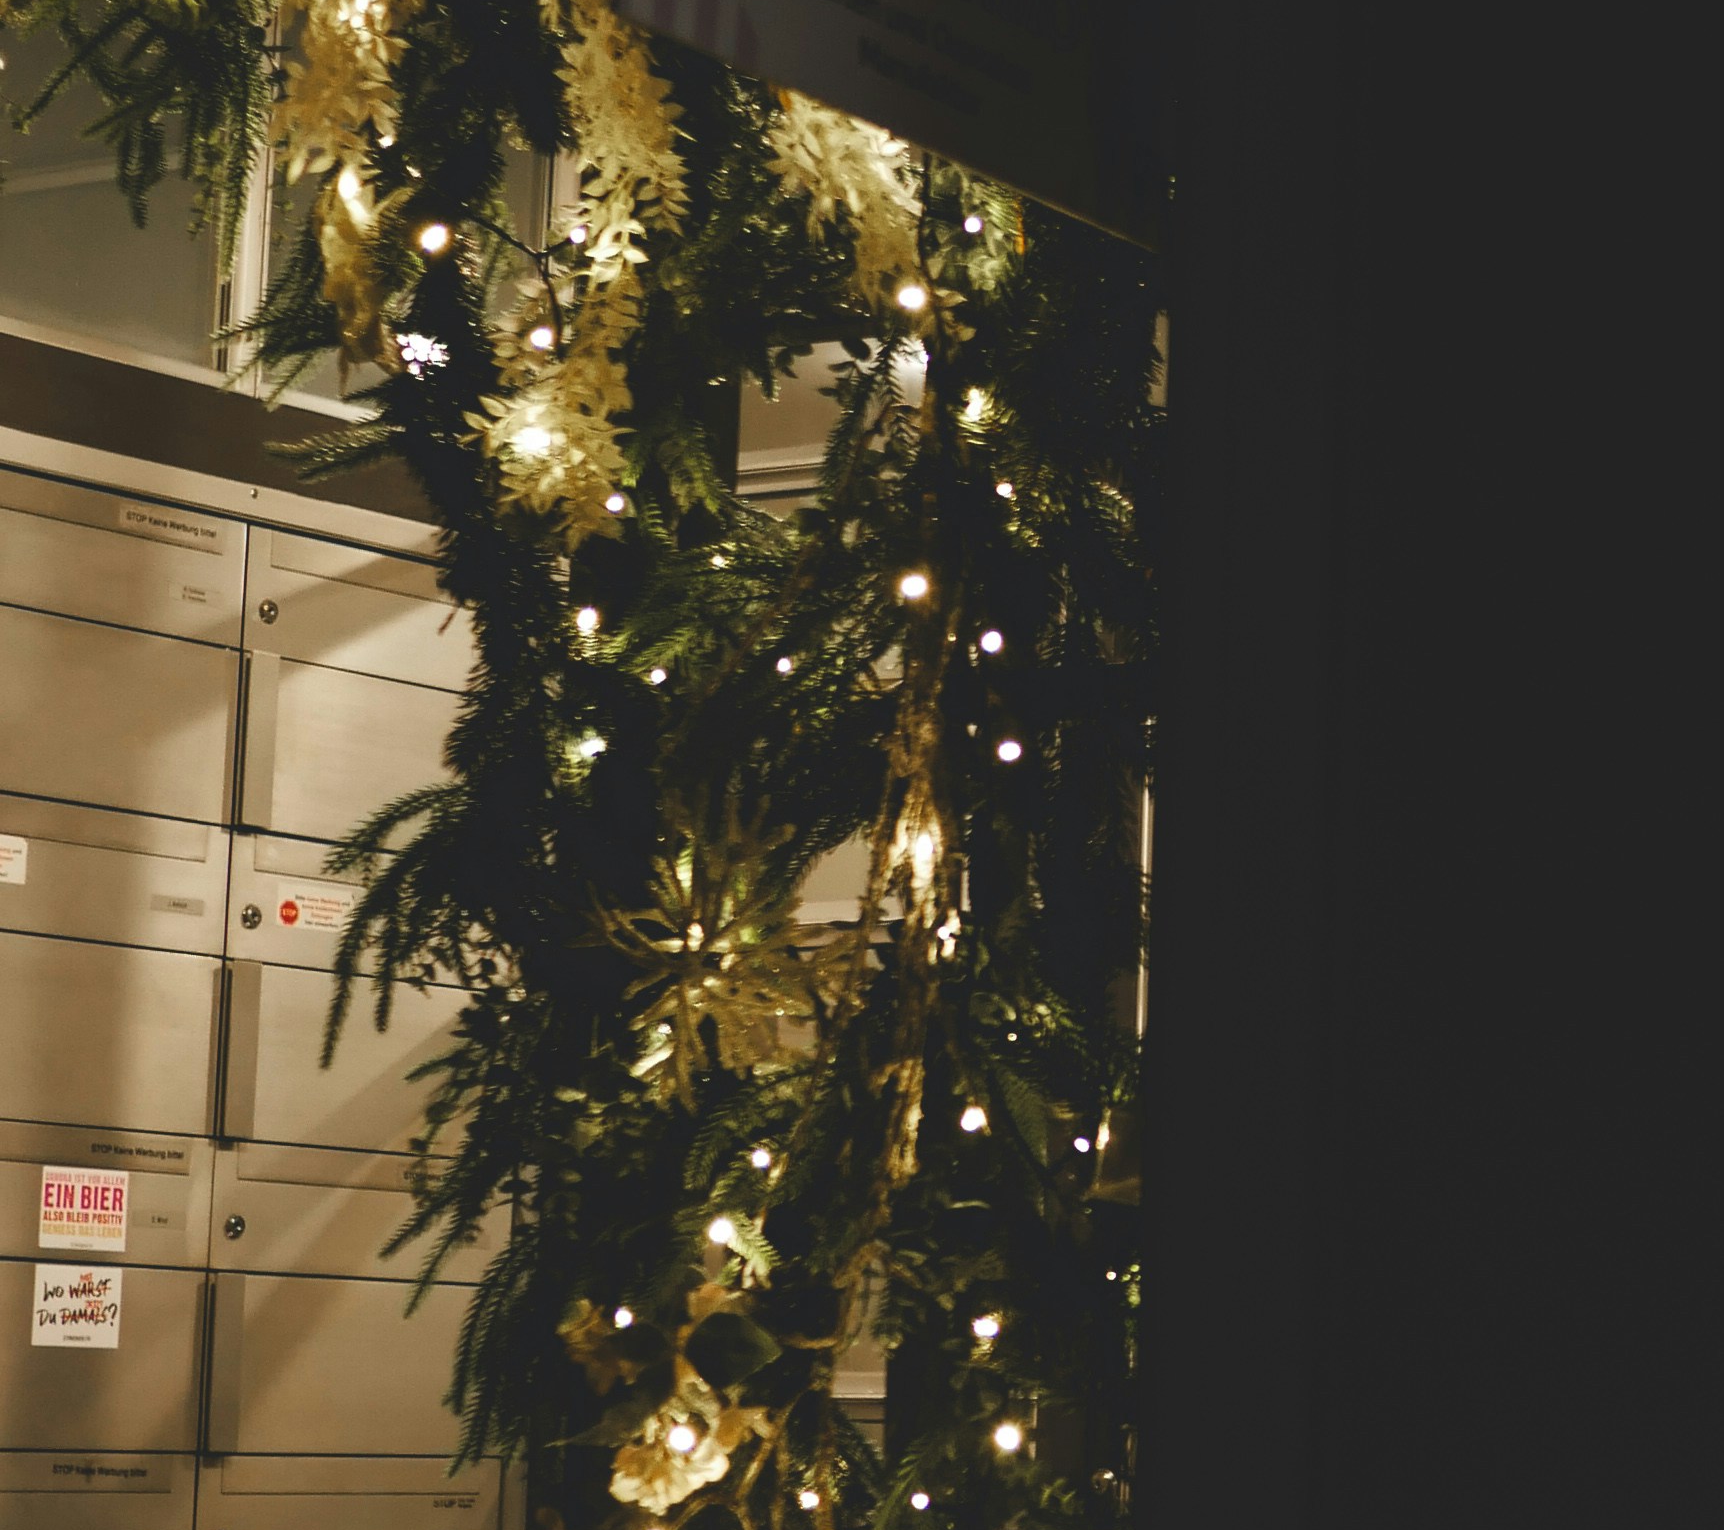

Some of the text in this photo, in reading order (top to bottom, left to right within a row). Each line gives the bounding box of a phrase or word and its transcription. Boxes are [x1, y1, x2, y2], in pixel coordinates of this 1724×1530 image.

[126, 510, 147, 522] STOP
[91, 1143, 112, 1154] STOP
[44, 1183, 124, 1212] EIN BIER
[43, 1210, 123, 1226] ALSO BLEIB POSITIV
